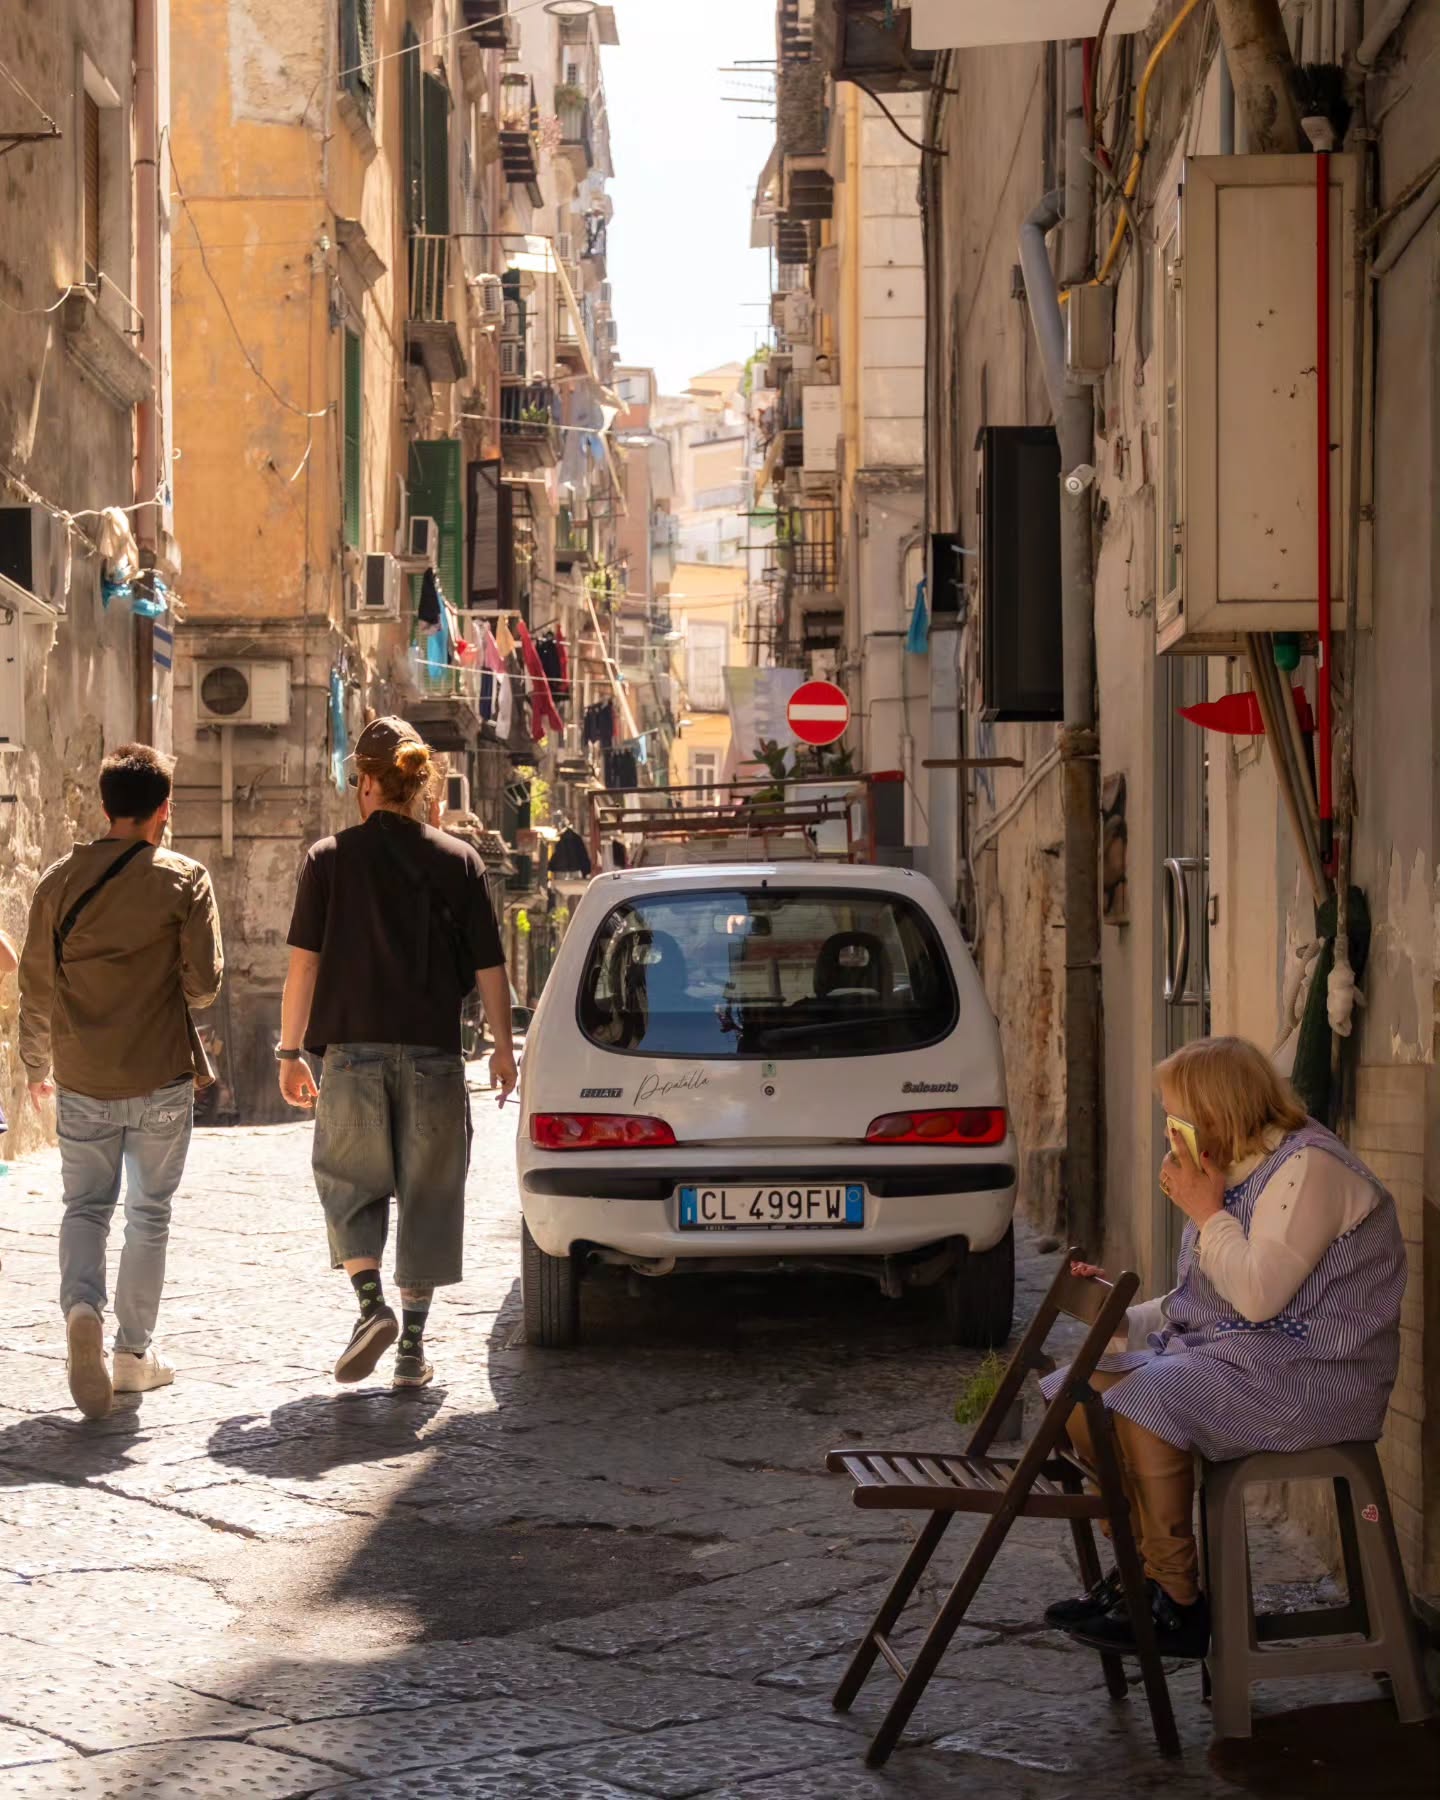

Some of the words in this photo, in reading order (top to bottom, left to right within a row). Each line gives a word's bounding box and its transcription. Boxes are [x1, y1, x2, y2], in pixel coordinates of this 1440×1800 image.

[581, 1089, 622, 1097] FIAT
[701, 1191, 736, 1220] CL
[749, 1190, 841, 1220] 499FW
